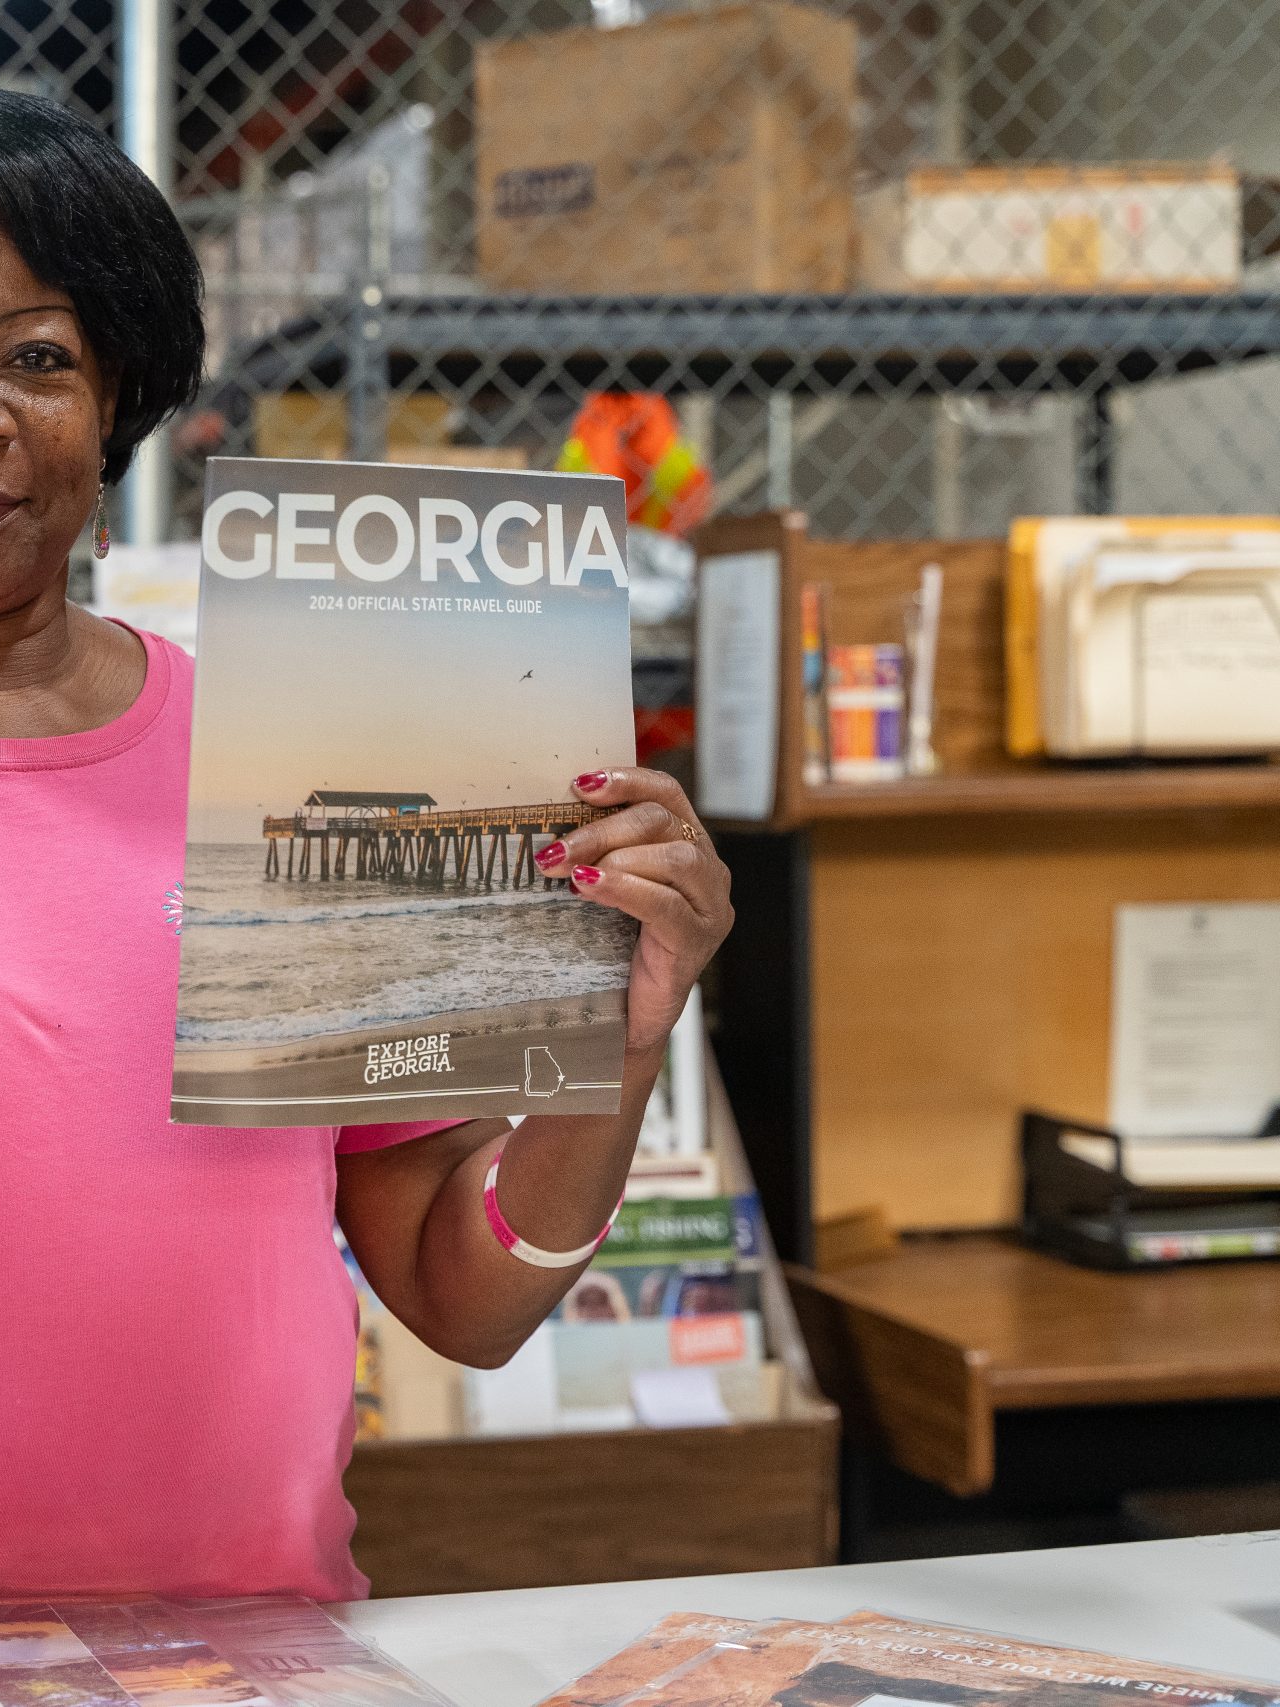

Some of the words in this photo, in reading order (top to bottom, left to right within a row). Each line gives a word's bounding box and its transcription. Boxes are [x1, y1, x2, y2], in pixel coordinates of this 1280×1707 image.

[202, 490, 629, 588] GEORGIA
[309, 596, 344, 610] 2024
[347, 596, 409, 611] OFFICIAL
[411, 597, 452, 612] STATE
[454, 598, 504, 613] TRAVEL
[506, 600, 543, 614] GUIDE
[366, 1033, 451, 1065] EXPLORE
[363, 1052, 453, 1085] GEORGIA
[790, 1628, 870, 1647] NEXT?
[875, 1641, 997, 1667] EXPLORE
[1001, 1662, 1055, 1677] YOU
[1064, 1670, 1131, 1688] WILL
[1134, 1681, 1237, 1704] WHERE
